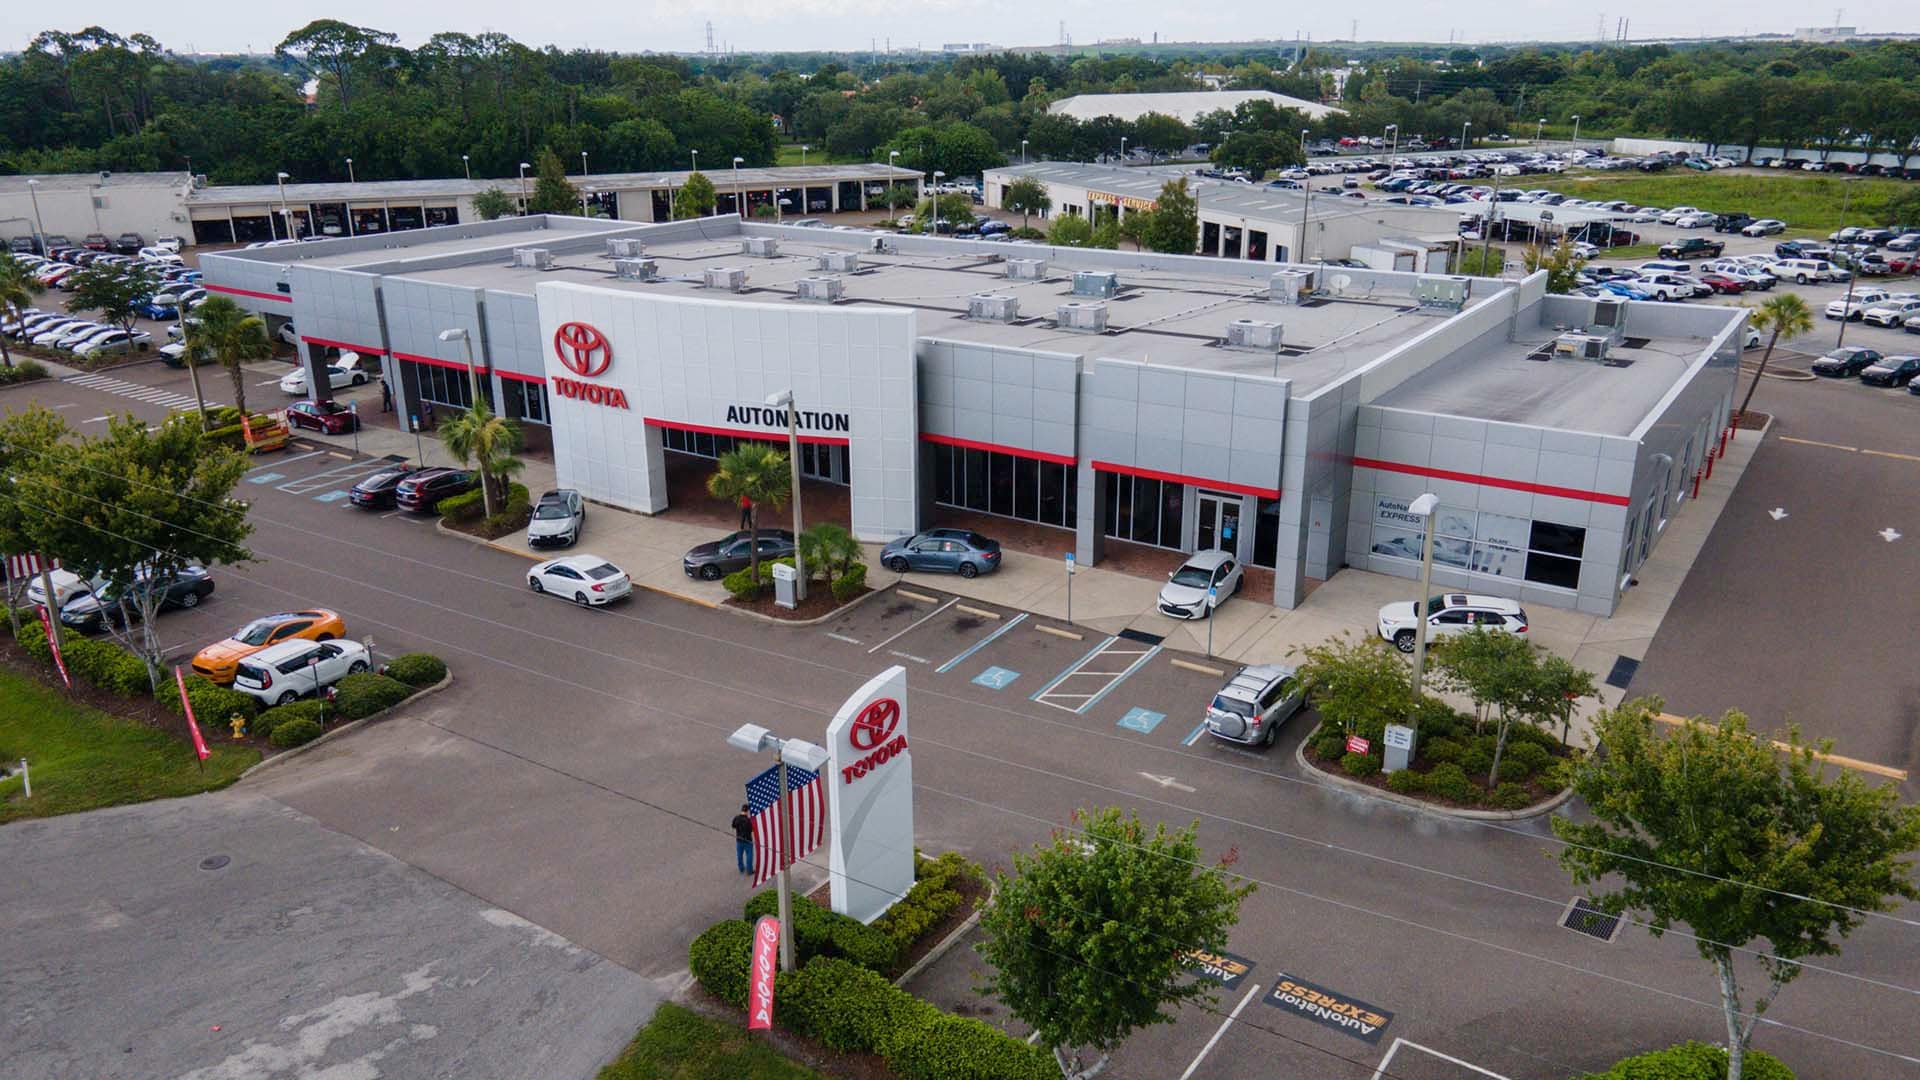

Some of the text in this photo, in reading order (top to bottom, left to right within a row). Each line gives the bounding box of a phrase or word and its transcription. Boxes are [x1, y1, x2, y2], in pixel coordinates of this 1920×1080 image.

[1122, 196, 1153, 210] SERVICE
[551, 376, 630, 410] TOYOTA
[726, 405, 850, 432] AUTONATION
[1378, 500, 1410, 512] AutoNa
[1380, 510, 1421, 524] EXPRESS
[842, 734, 908, 785] TOYOTA
[756, 939, 771, 1026] TOYOTA
[1273, 989, 1377, 1035] AutoNation
[1277, 980, 1389, 1028] EXPRESS
